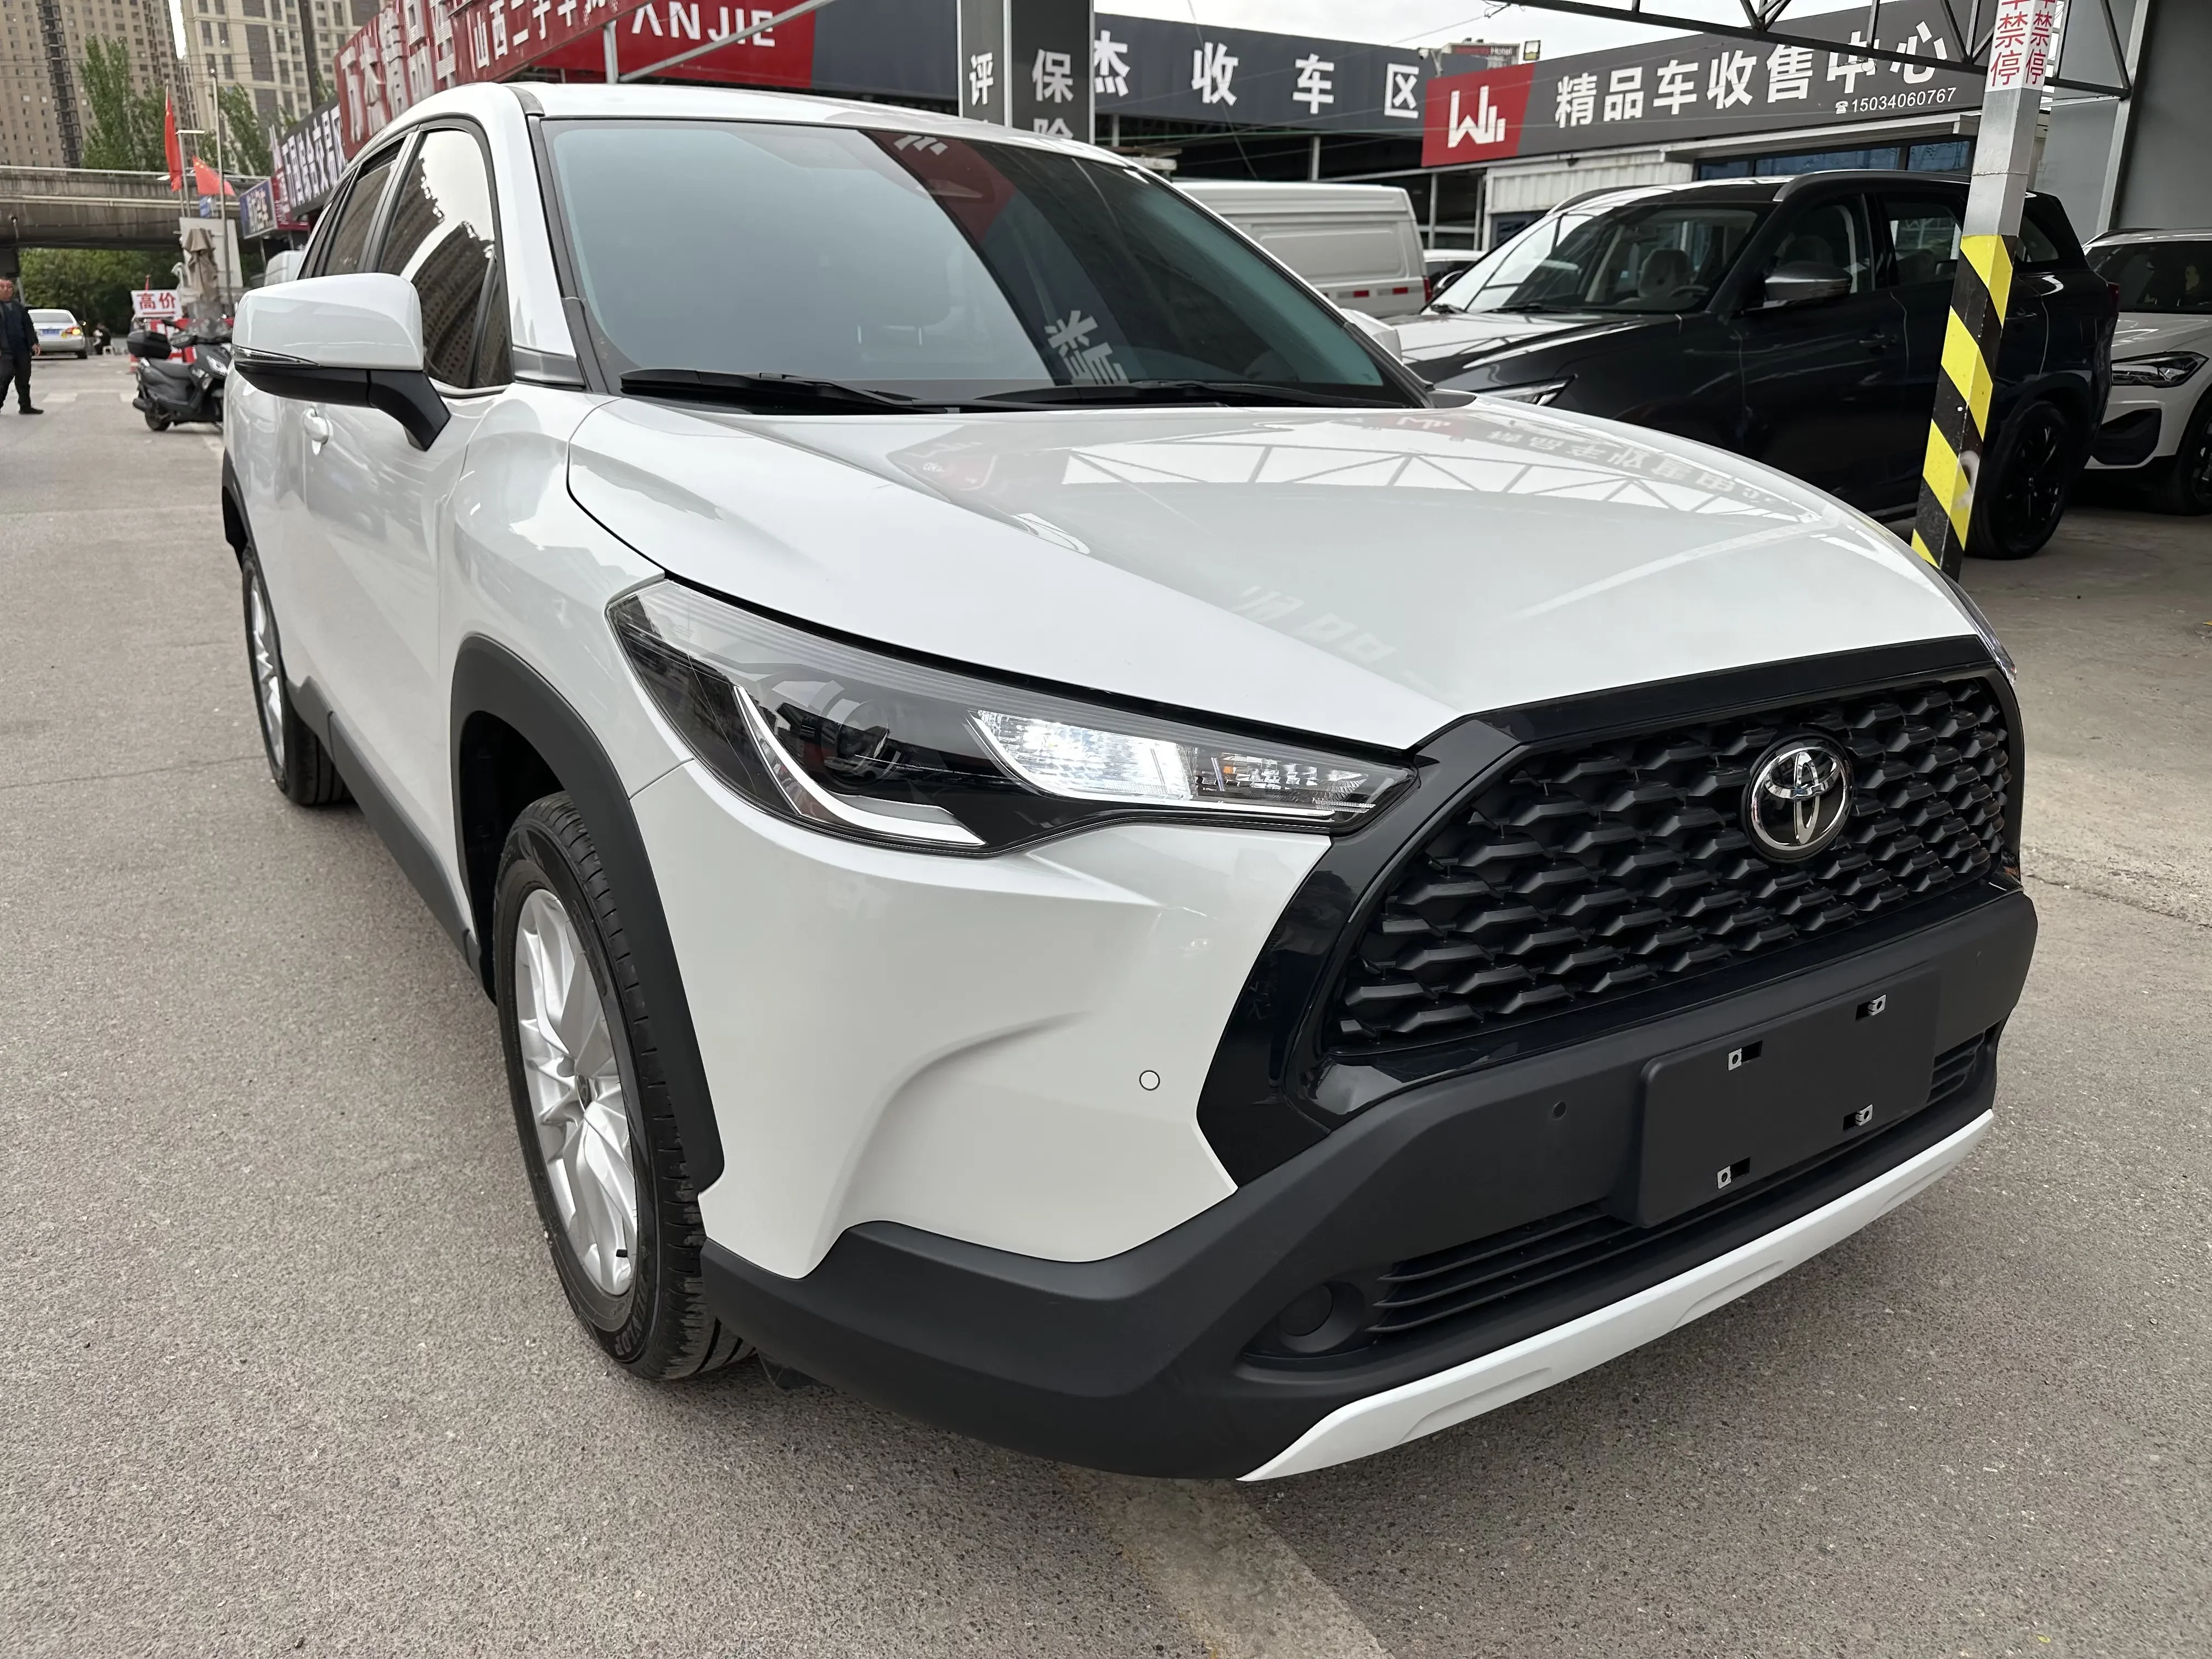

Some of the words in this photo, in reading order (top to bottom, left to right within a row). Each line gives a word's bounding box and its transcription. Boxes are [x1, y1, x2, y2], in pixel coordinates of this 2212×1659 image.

[1555, 21, 1948, 128] 精品车收售中心
[1990, 0, 2029, 87] 禁停
[2026, 0, 2055, 84] 禁停
[1852, 87, 1956, 112] 15034060767
[136, 292, 176, 309] 高价
